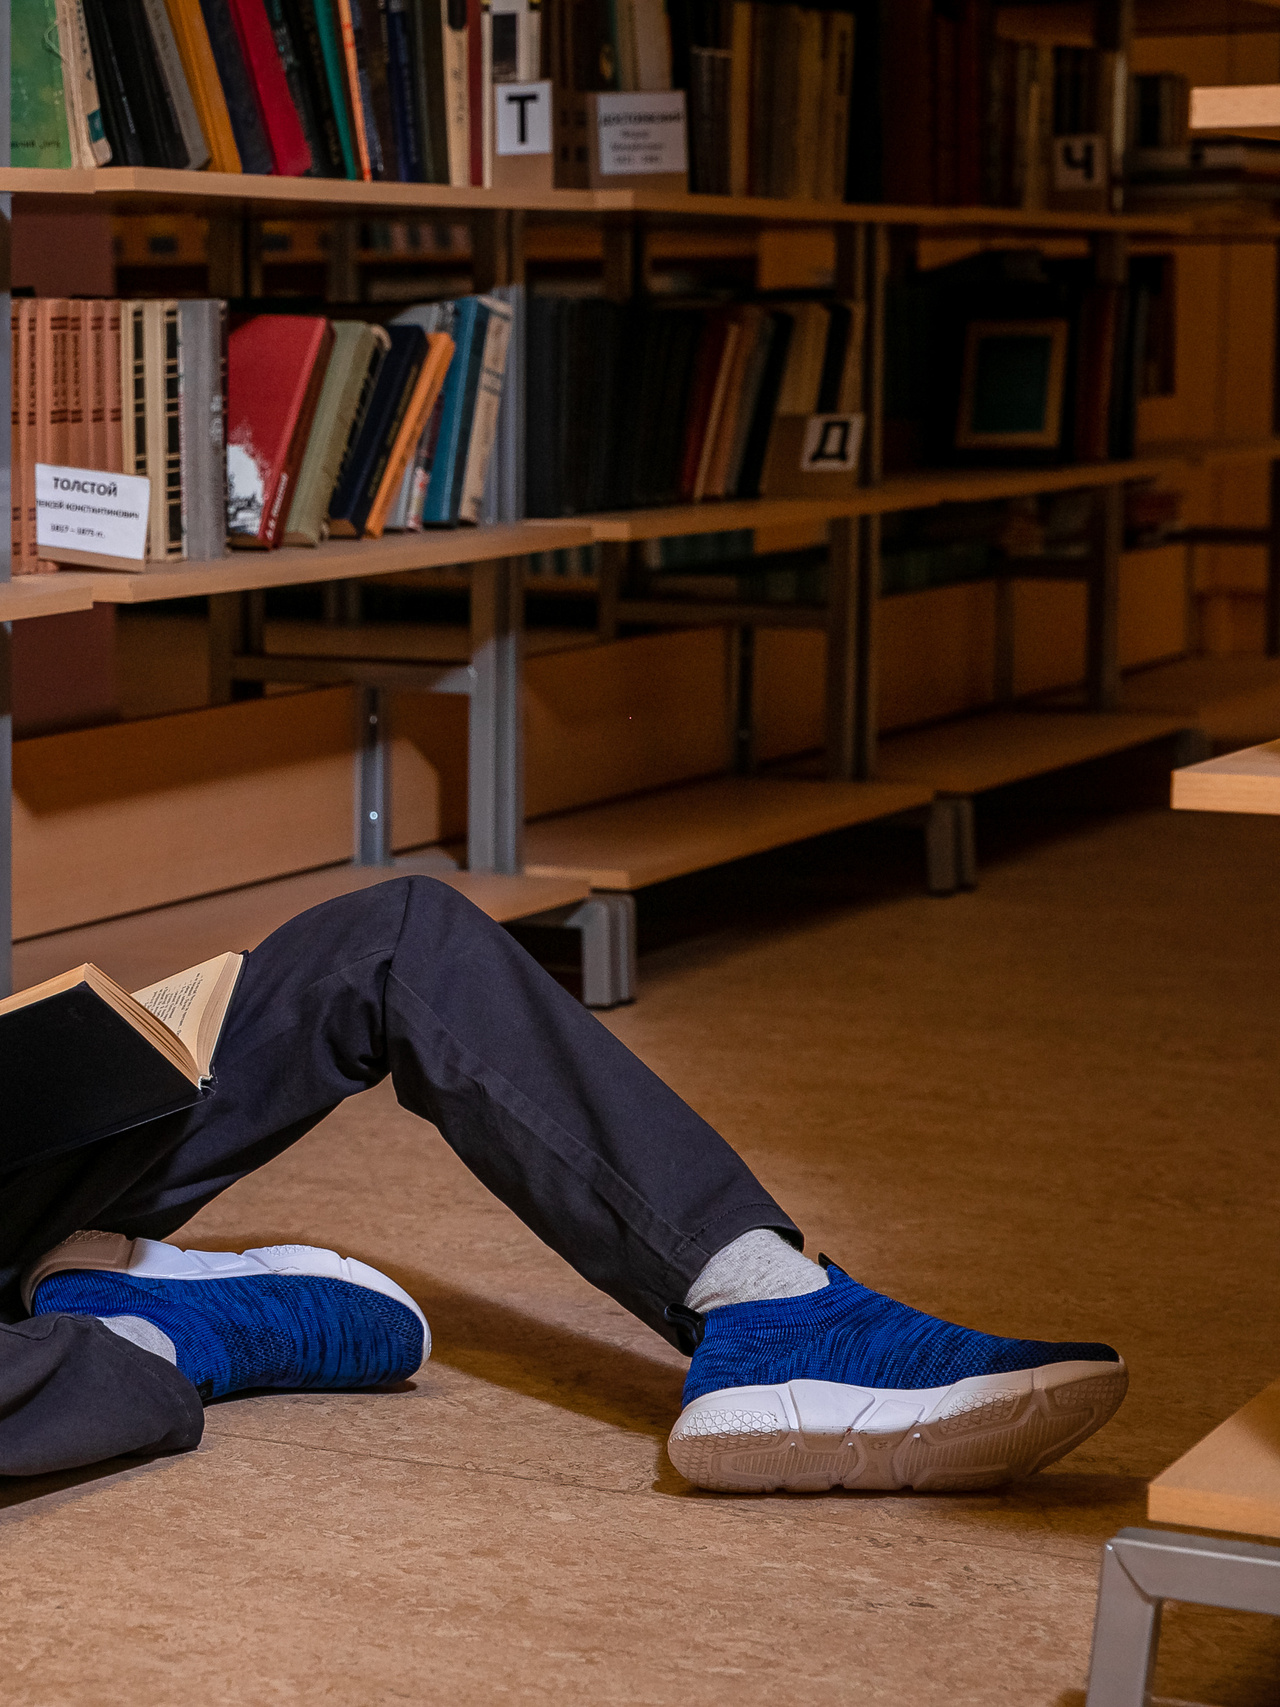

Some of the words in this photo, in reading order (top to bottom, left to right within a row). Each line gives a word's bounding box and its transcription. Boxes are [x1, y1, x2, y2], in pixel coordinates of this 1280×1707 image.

[506, 93, 537, 143] Т
[810, 421, 850, 462] Д
[53, 477, 117, 497] ТОЛСТОЙ
